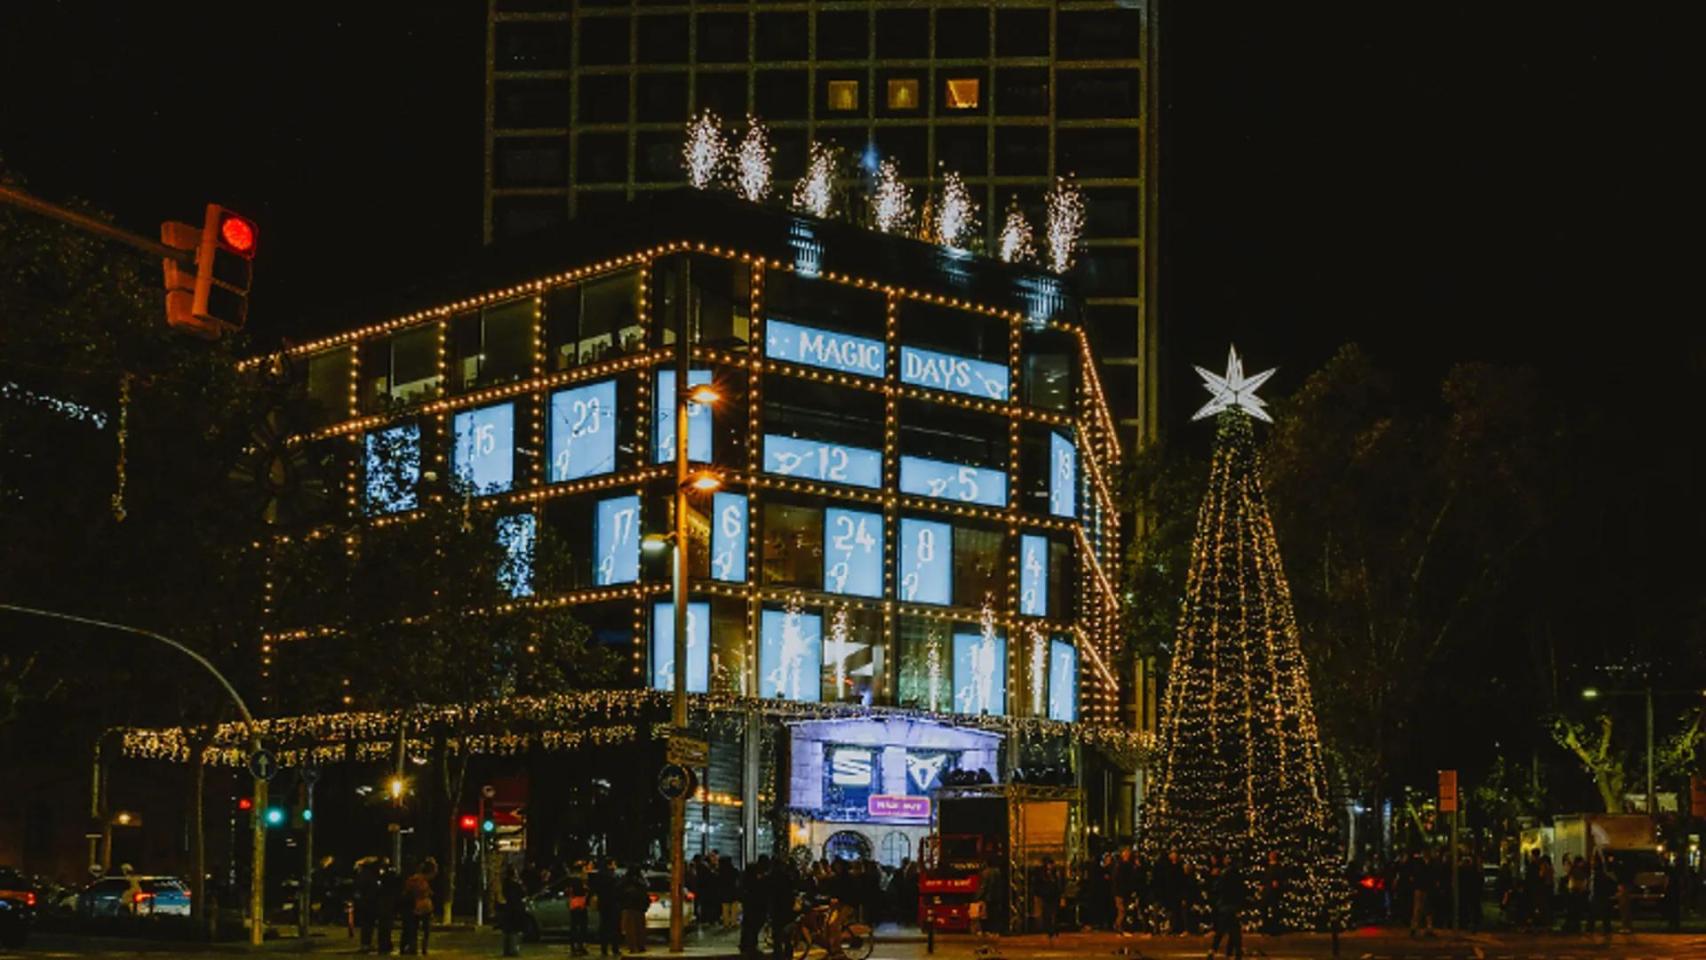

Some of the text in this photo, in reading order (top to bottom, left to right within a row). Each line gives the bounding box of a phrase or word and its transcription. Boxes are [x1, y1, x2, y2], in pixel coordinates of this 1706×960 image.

[800, 331, 971, 391] MAGIC DAYS
[571, 397, 600, 439] 23
[475, 423, 495, 457] 15
[818, 445, 849, 481] 12
[958, 466, 979, 501] 5
[613, 508, 635, 545] 17
[722, 505, 741, 538] 6
[833, 515, 876, 553] 24
[917, 528, 934, 562] 8
[1025, 546, 1042, 577] 4
[1060, 652, 1071, 681] 7
